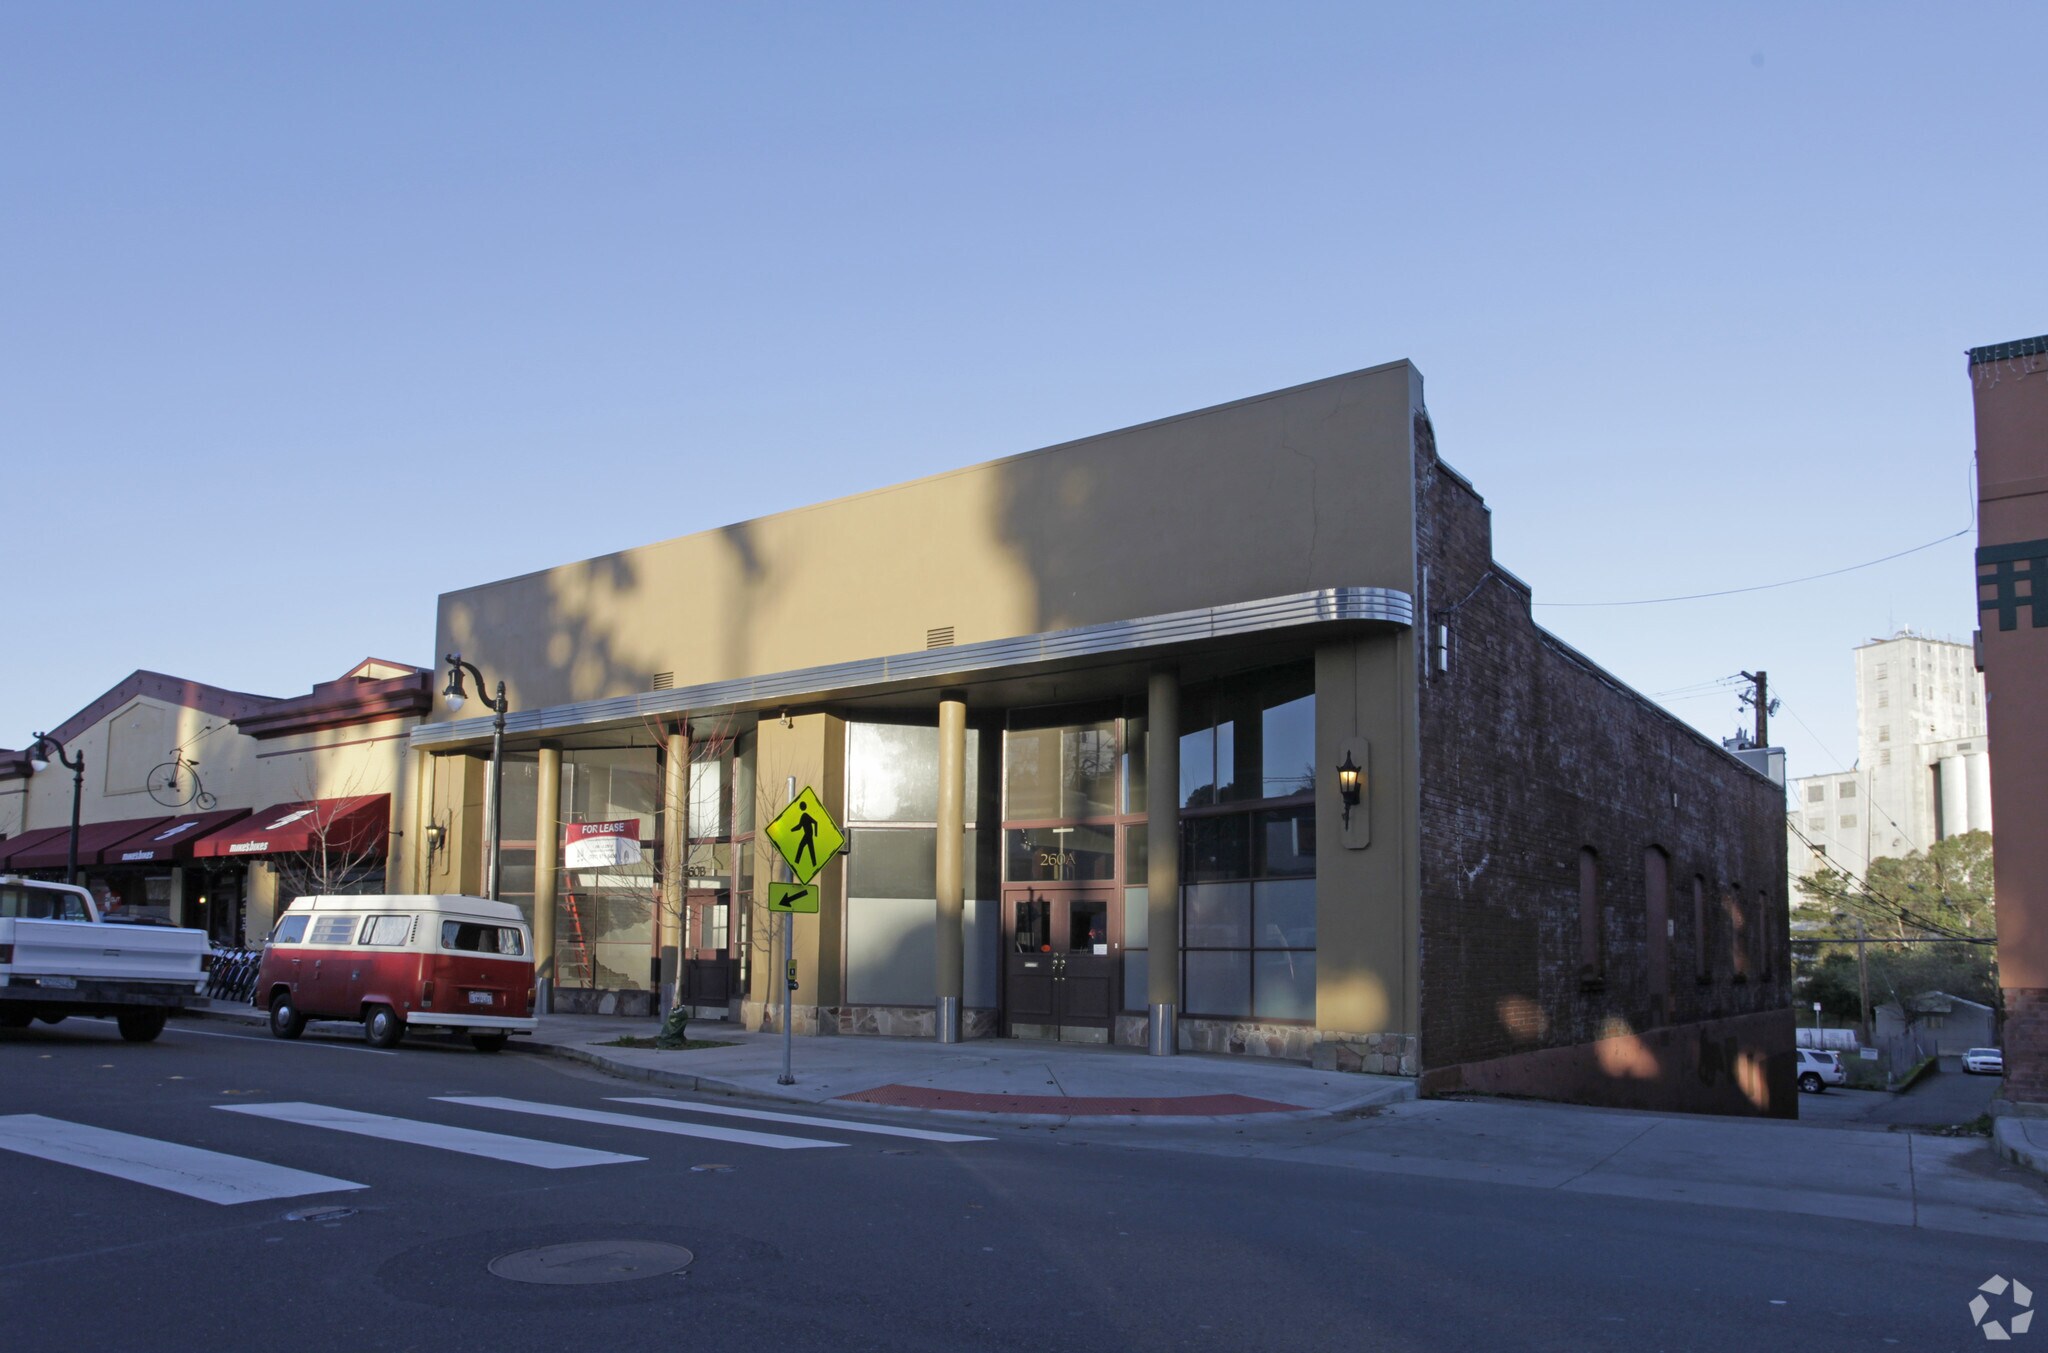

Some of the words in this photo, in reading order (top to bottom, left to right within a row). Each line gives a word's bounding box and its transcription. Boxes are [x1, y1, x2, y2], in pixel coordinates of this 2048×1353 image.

[582, 825, 598, 834] FOR
[599, 823, 625, 833] LEASE
[1040, 853, 1076, 866] 260A
[687, 866, 706, 877] 60B
